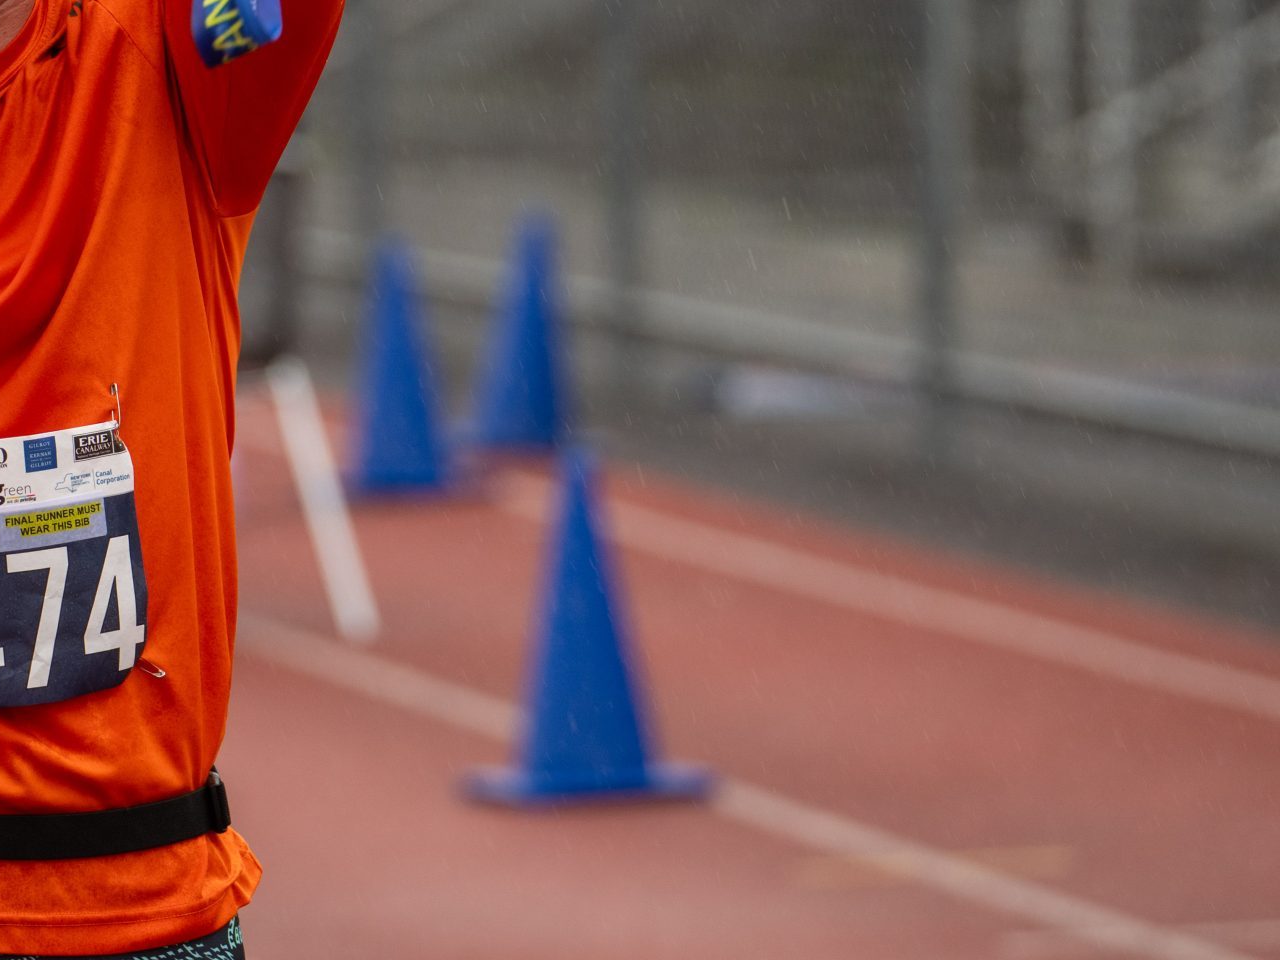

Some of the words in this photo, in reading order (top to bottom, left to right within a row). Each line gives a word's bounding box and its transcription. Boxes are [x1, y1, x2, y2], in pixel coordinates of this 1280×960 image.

[28, 441, 51, 450] GILROY
[79, 433, 108, 447] ERIE
[75, 441, 112, 456] CANALWAY
[95, 468, 113, 478] Canal
[96, 474, 130, 486] Corporation
[5, 514, 35, 527] FINAL
[36, 508, 75, 522] RUNNER
[77, 503, 102, 515] MUST
[20, 524, 50, 536] WEAR
[52, 520, 74, 530] THIS
[75, 517, 91, 527] BIB
